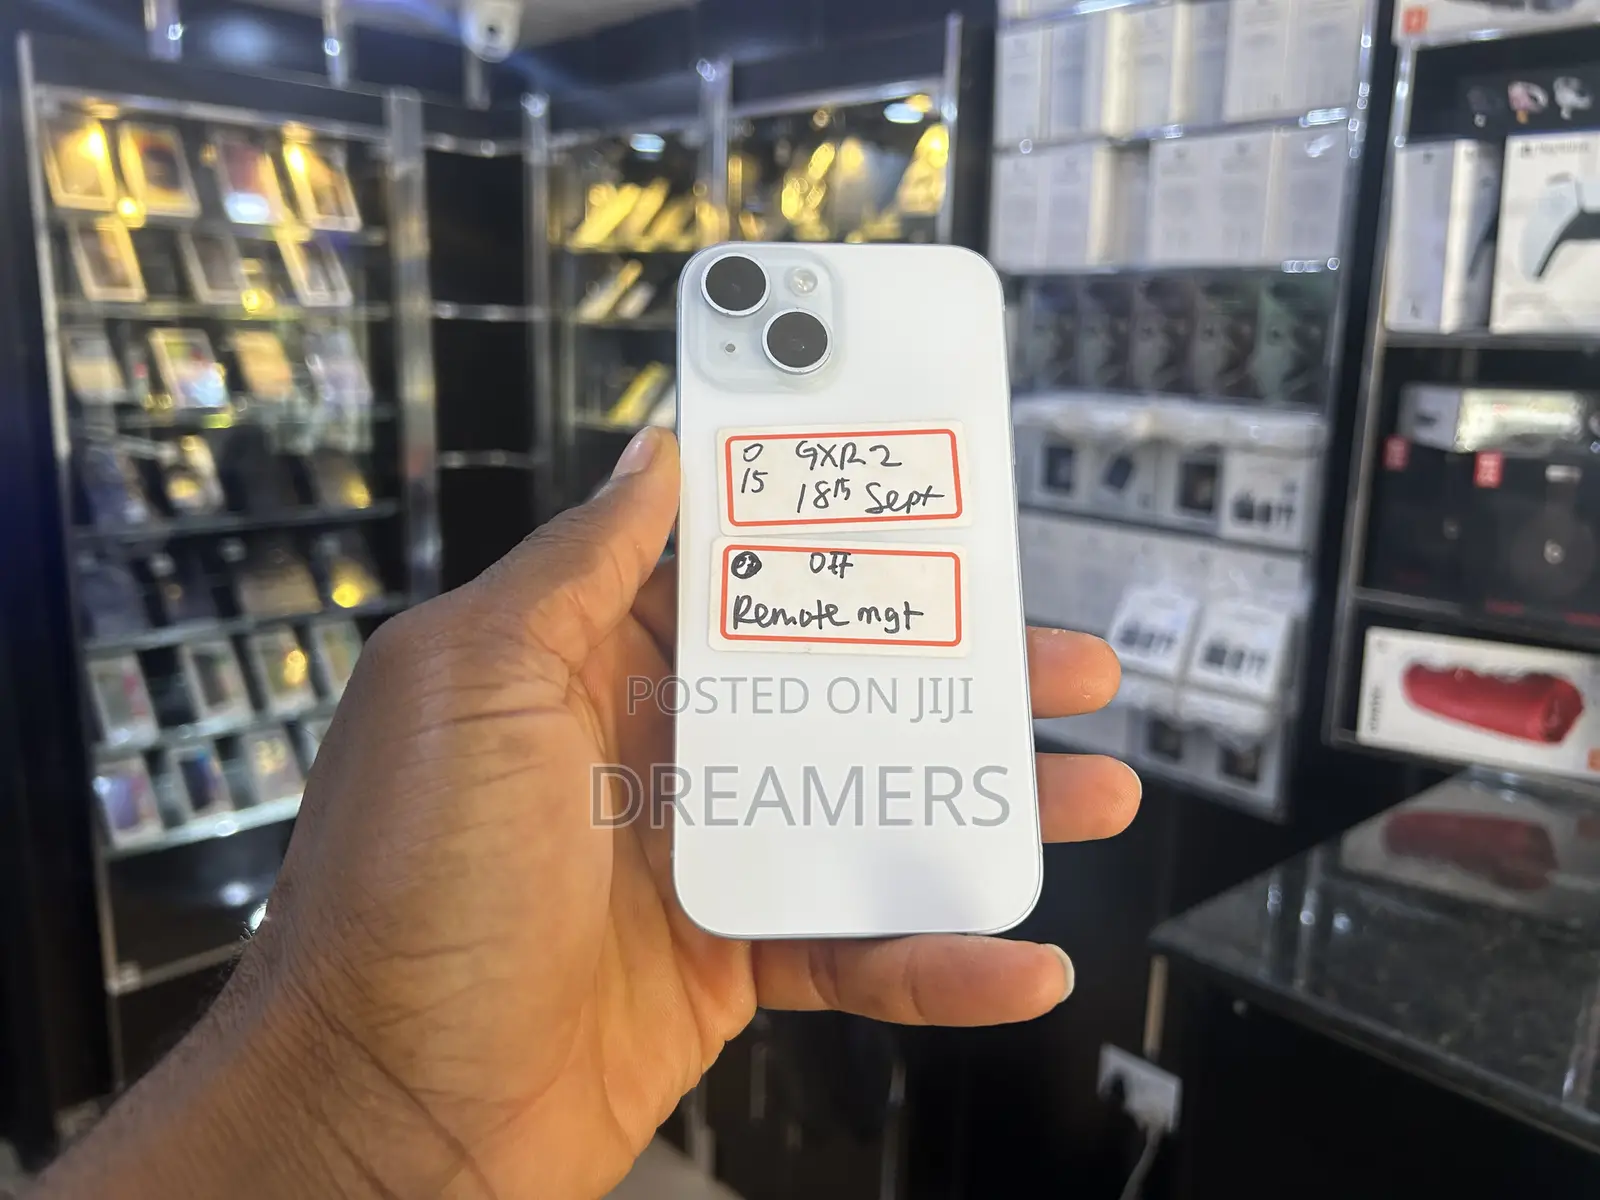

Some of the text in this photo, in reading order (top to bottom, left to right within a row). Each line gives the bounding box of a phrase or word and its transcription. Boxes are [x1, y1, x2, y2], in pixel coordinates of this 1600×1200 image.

[741, 468, 768, 493] 15
[865, 482, 945, 514] Sept
[733, 594, 924, 633] Remote mgt
